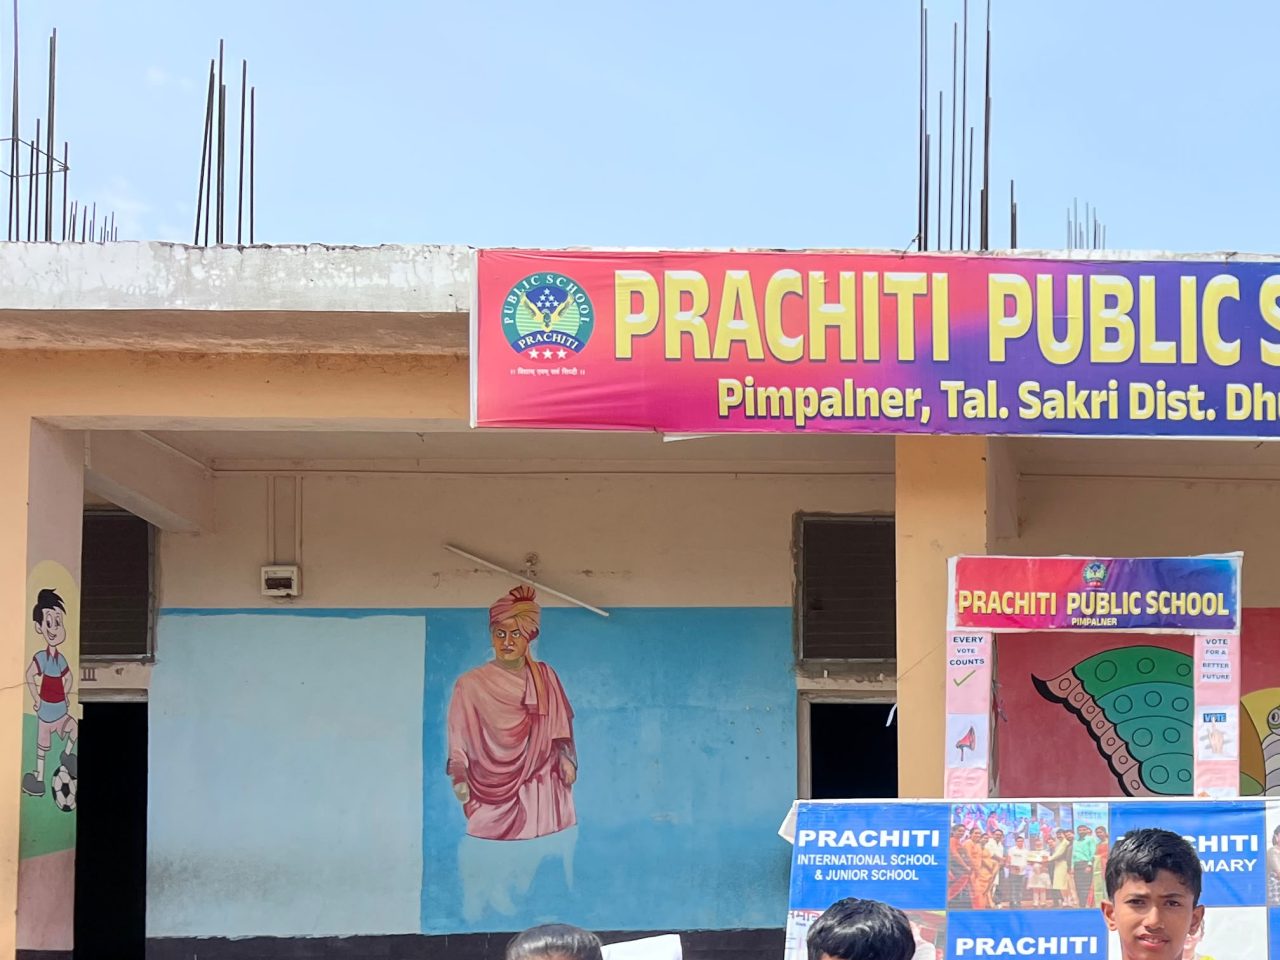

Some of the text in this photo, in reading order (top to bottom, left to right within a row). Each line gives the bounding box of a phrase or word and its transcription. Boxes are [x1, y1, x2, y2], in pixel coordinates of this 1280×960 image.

[504, 274, 591, 324] PUBLIC SCHOOL
[614, 269, 949, 362] PRACHITI
[988, 272, 1241, 367] PUBLIC
[518, 333, 579, 349] PRACHITI
[718, 378, 931, 426] Pimpalner,
[940, 380, 1009, 420] Tal.
[1018, 380, 1119, 421] Sakri
[1130, 381, 1216, 422] Dist.
[957, 590, 1230, 616] PRACHITI PUBLIC SCHOOL
[1071, 617, 1118, 626] PIMPALNER
[953, 636, 984, 644] EVERY
[949, 658, 985, 666] COUNTS
[81, 667, 97, 681] III
[798, 830, 940, 847] PRACHITI
[797, 854, 938, 865] INTERNATIONAL SCHOOL
[1200, 859, 1257, 872] MARY
[814, 869, 919, 880] & JUNIOR SCHOOL
[955, 936, 1097, 955] PRACHITI
